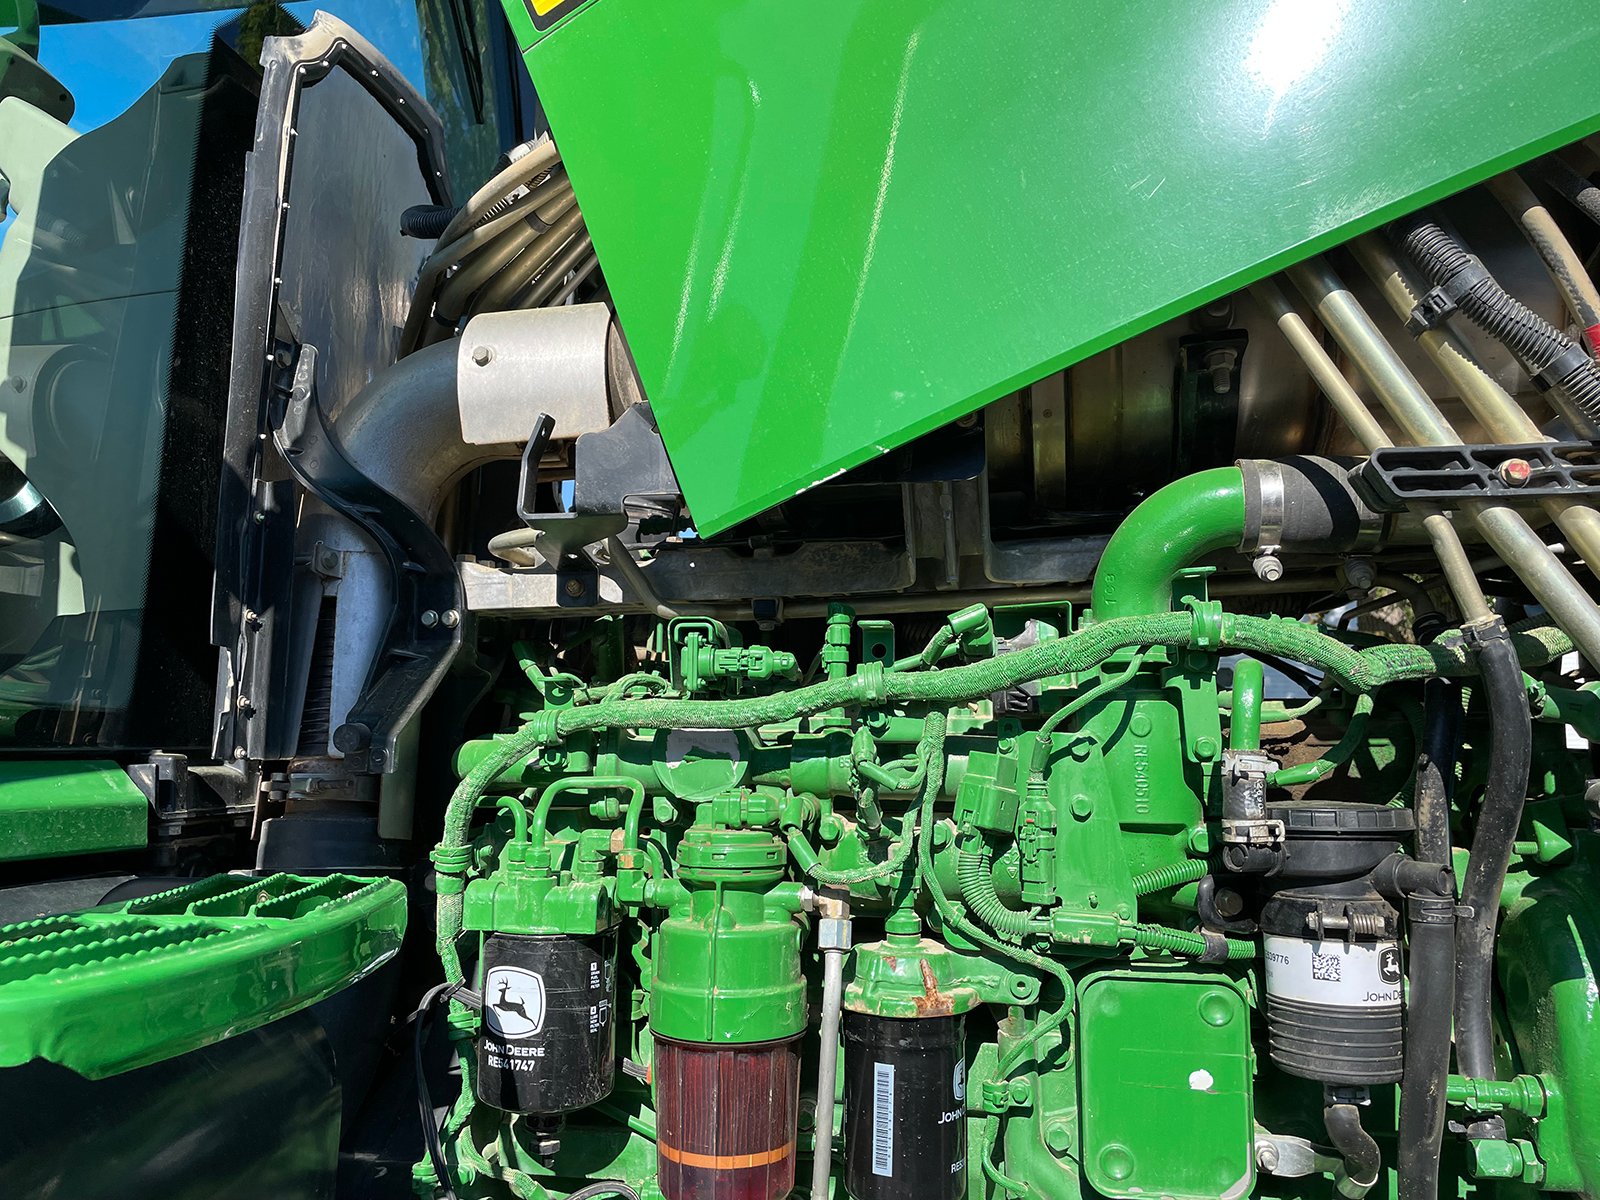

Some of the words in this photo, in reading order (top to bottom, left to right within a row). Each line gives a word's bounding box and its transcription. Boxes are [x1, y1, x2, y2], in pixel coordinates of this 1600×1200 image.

[1362, 991, 1392, 1002] JOHN
[484, 1040, 505, 1054] JOHN
[506, 1044, 545, 1056] DEERE
[488, 1055, 535, 1071] RE541747
